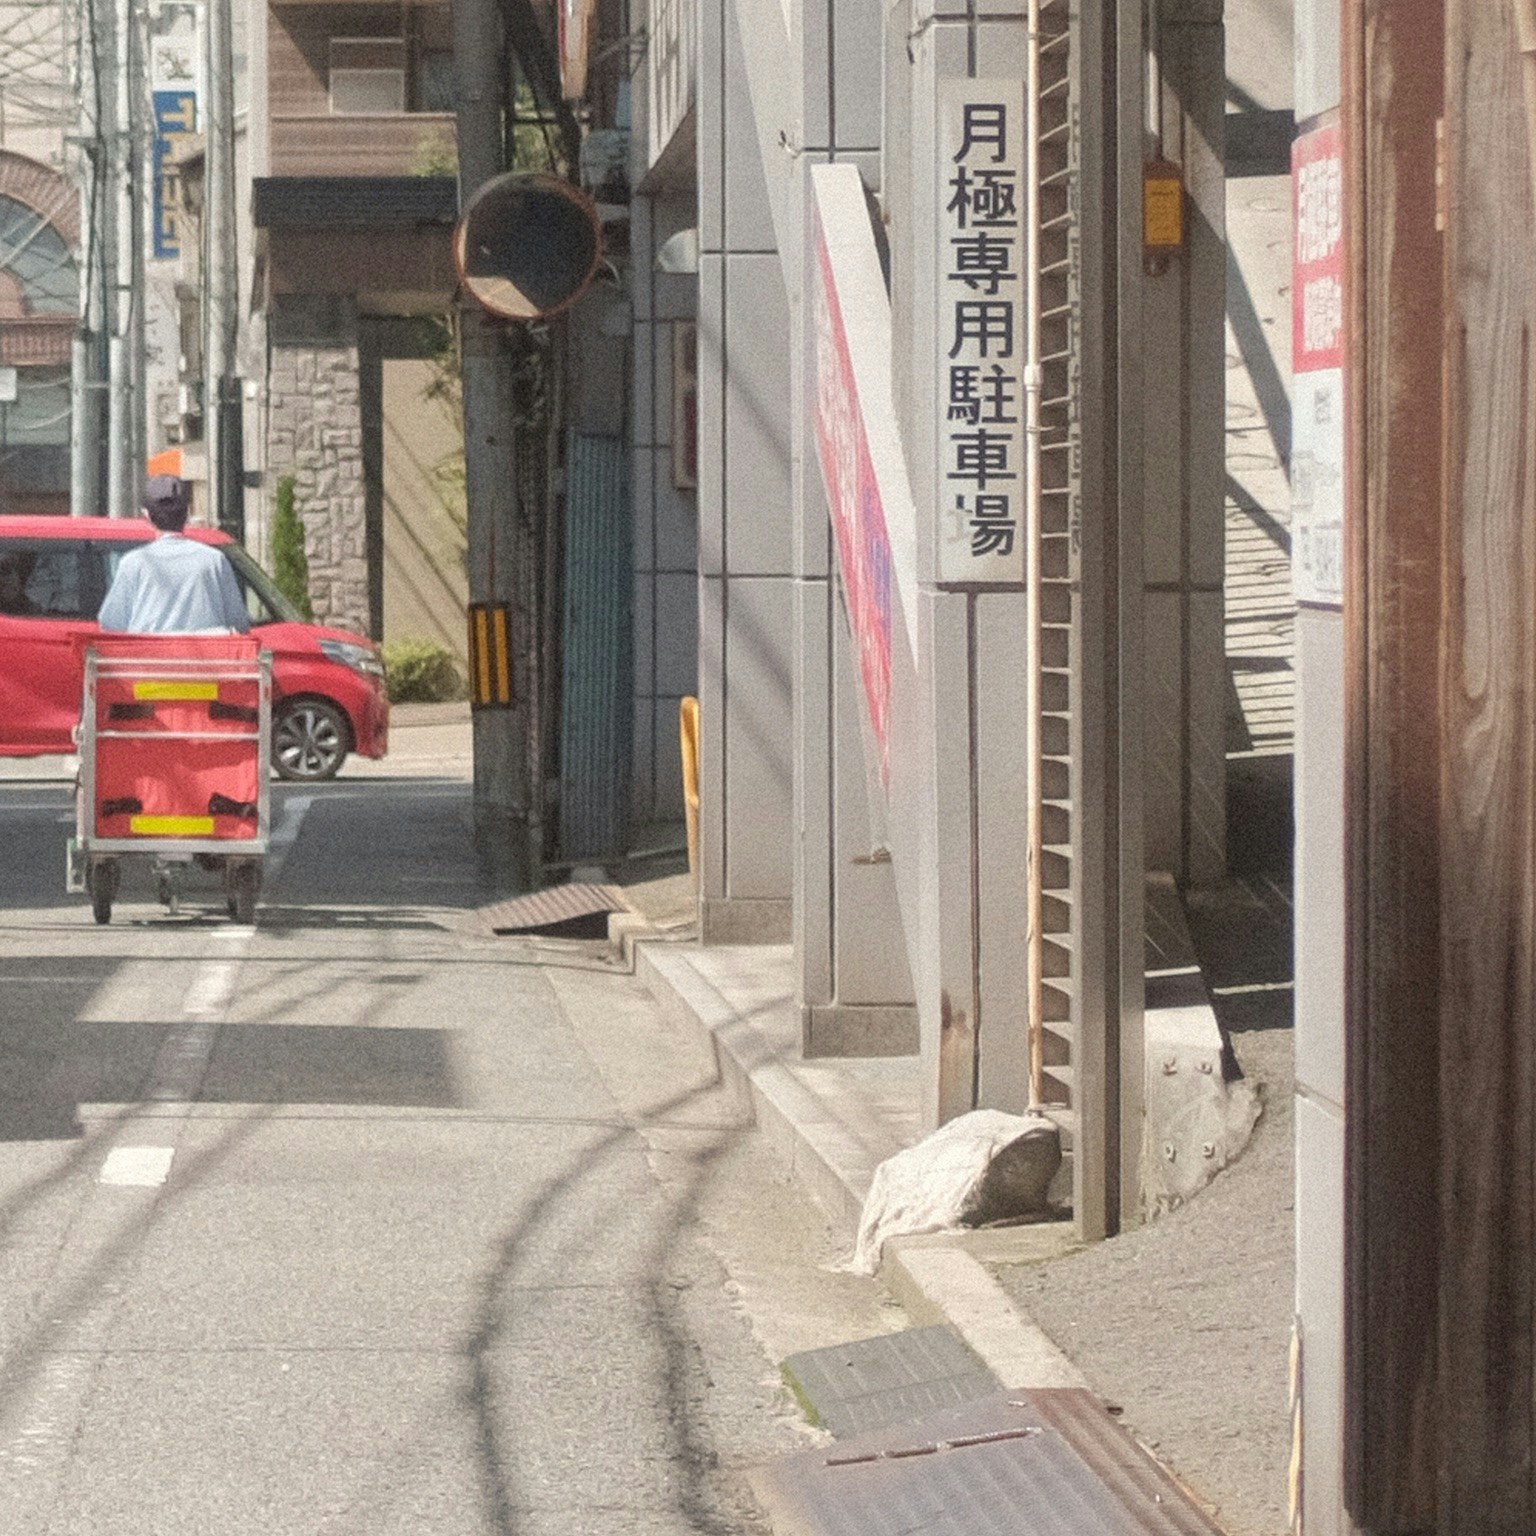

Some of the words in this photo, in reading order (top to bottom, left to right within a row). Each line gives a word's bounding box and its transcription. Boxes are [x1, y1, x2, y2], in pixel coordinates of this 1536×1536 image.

[946, 102, 1019, 558] 月極専用駐車場
